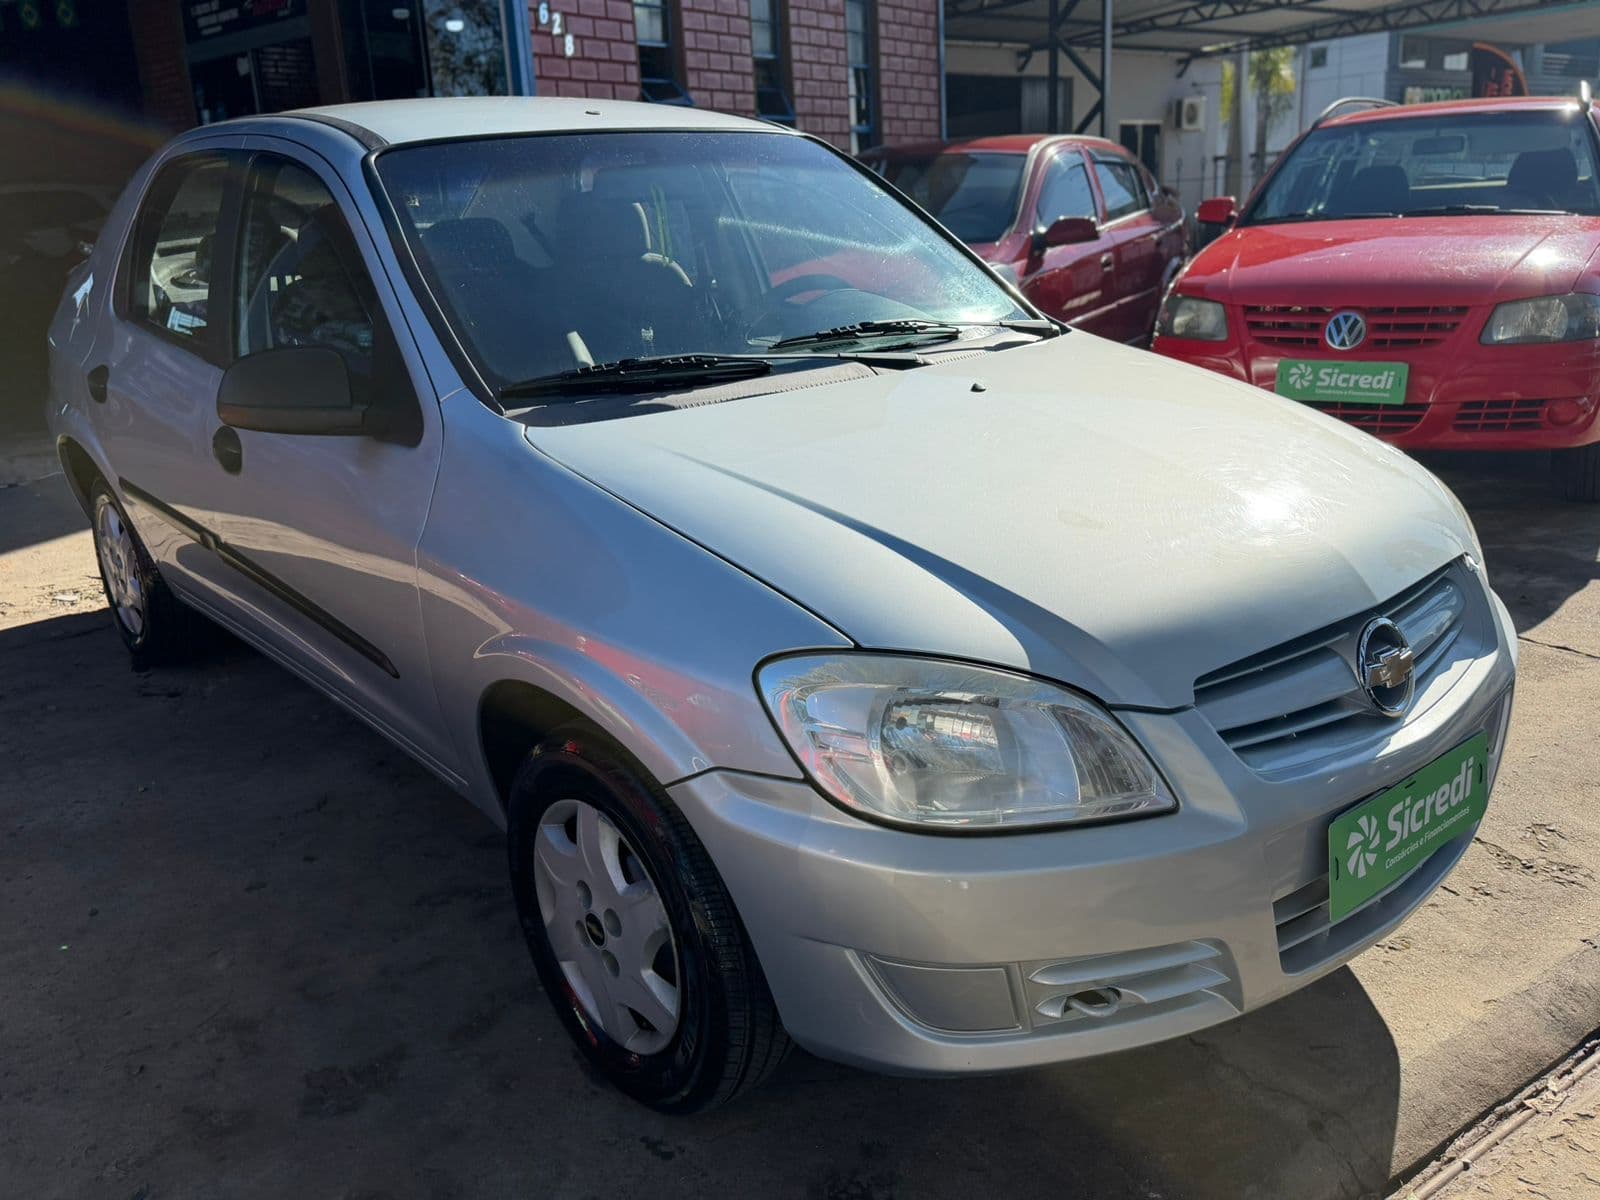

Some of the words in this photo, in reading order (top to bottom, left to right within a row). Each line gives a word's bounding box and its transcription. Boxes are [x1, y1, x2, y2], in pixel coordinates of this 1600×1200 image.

[539, 2, 574, 57] 628
[1316, 368, 1395, 389] Sicredi
[1385, 756, 1474, 852] Sicredi
